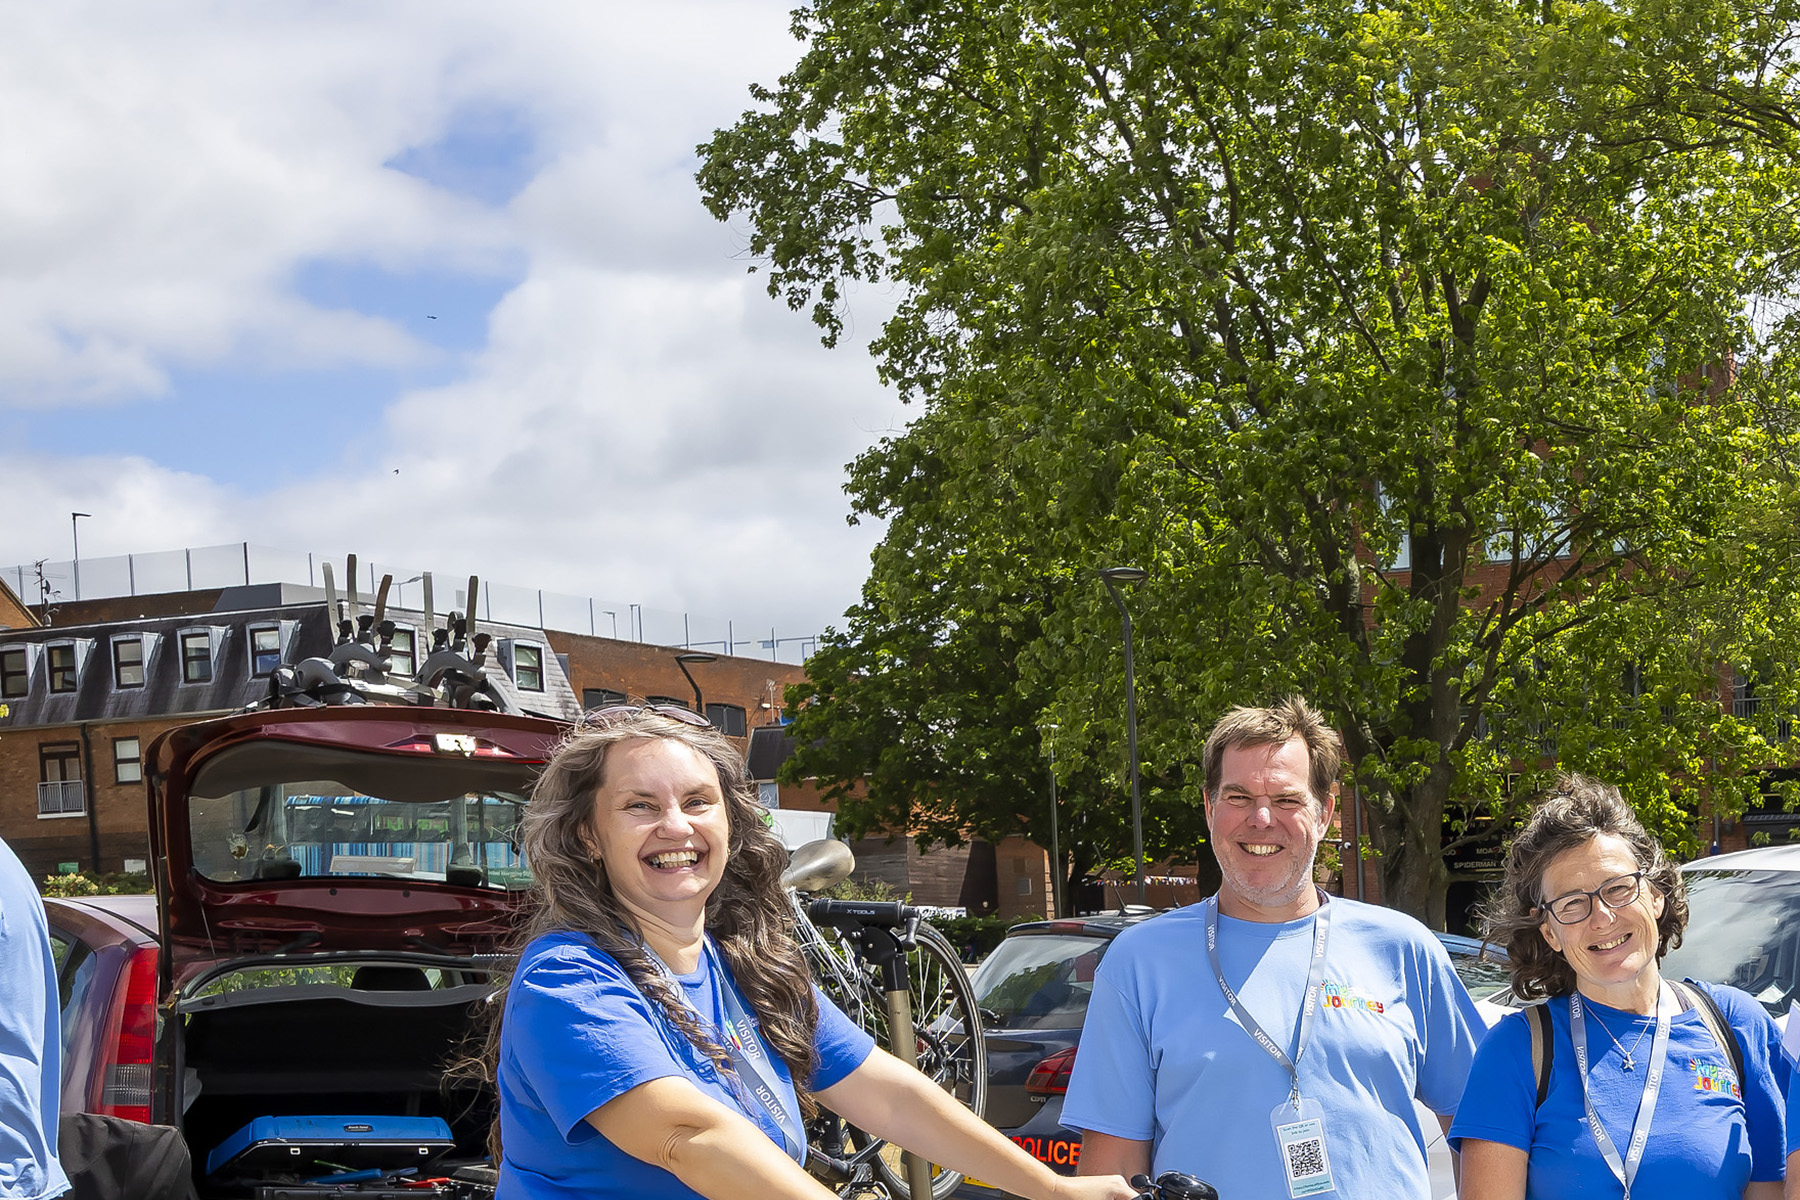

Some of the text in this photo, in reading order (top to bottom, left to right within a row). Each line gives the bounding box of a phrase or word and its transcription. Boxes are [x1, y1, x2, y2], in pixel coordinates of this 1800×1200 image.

[1218, 975, 1237, 1007] VISITOR
[736, 1019, 762, 1060] VISITOR
[1253, 1028, 1283, 1059] VISITOR
[756, 1085, 786, 1125] VISITOR
[1588, 1108, 1606, 1143] VISITOR
[1629, 1129, 1646, 1162] VISITOR
